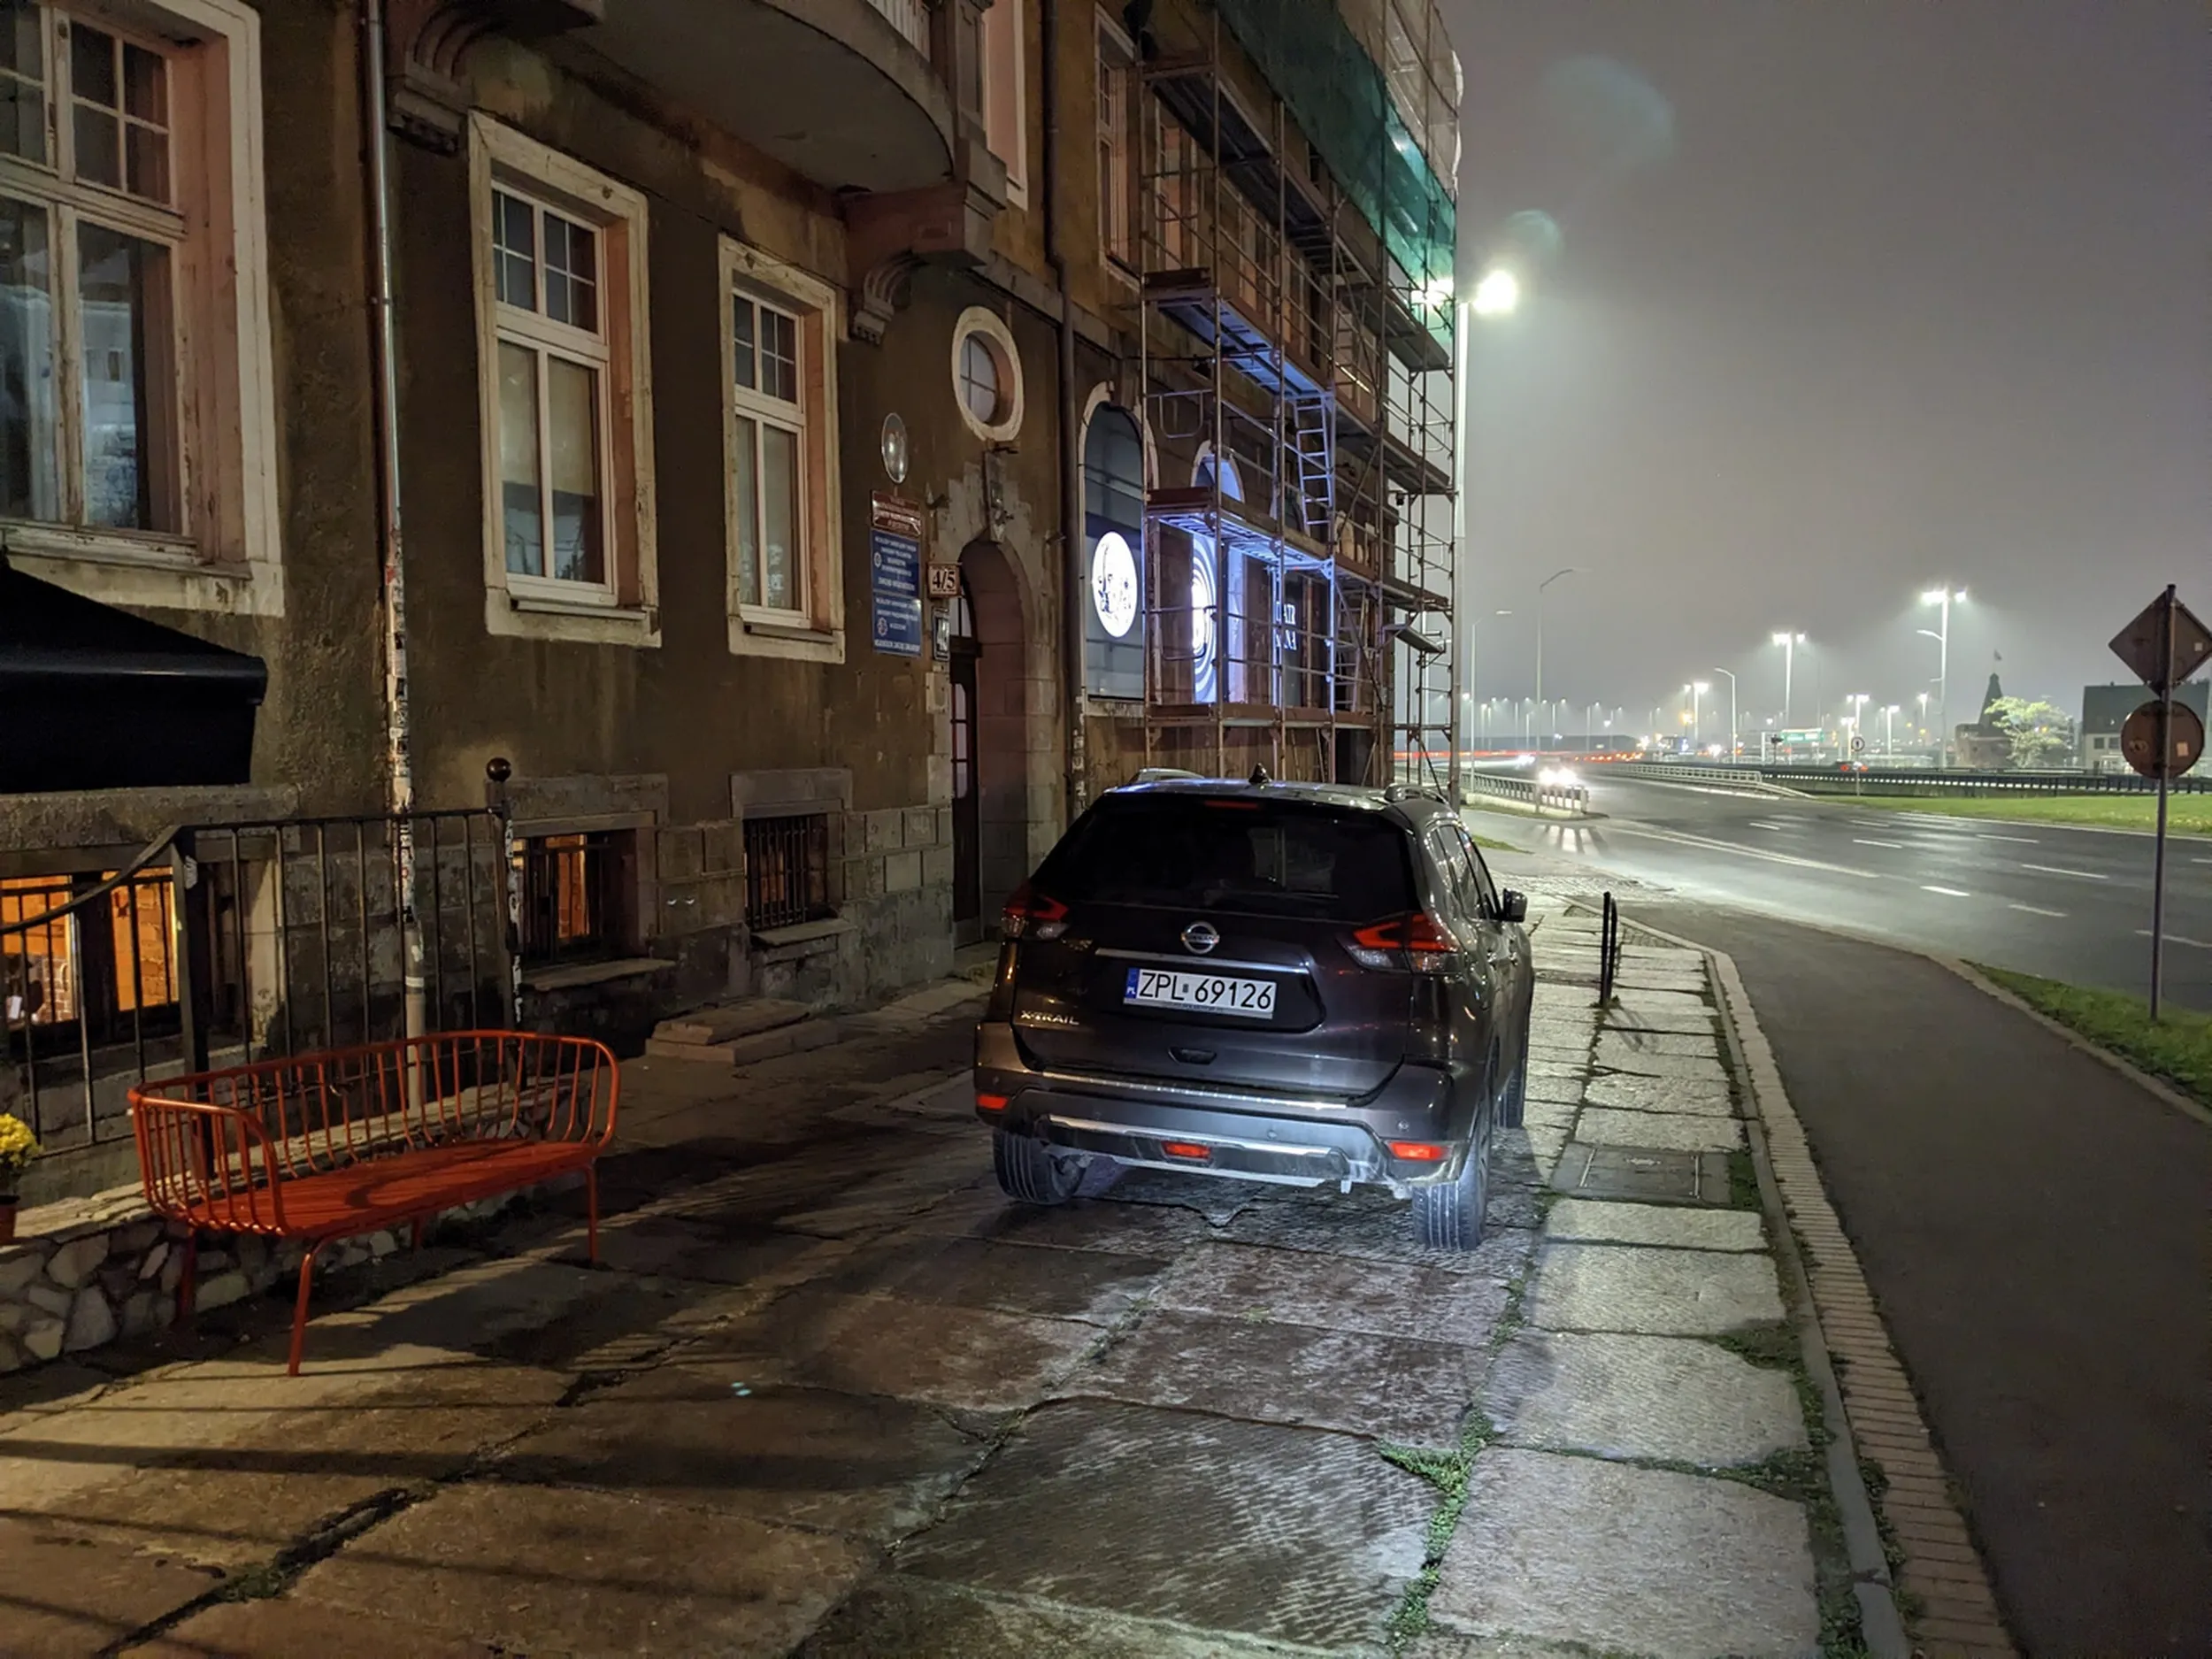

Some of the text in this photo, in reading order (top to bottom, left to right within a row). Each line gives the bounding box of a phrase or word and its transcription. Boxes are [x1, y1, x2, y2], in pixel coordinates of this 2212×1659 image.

[932, 570, 955, 588] 4/5
[1139, 972, 1272, 1010] ZPL 69126
[1020, 1010, 1079, 1025] X-TRAIL
